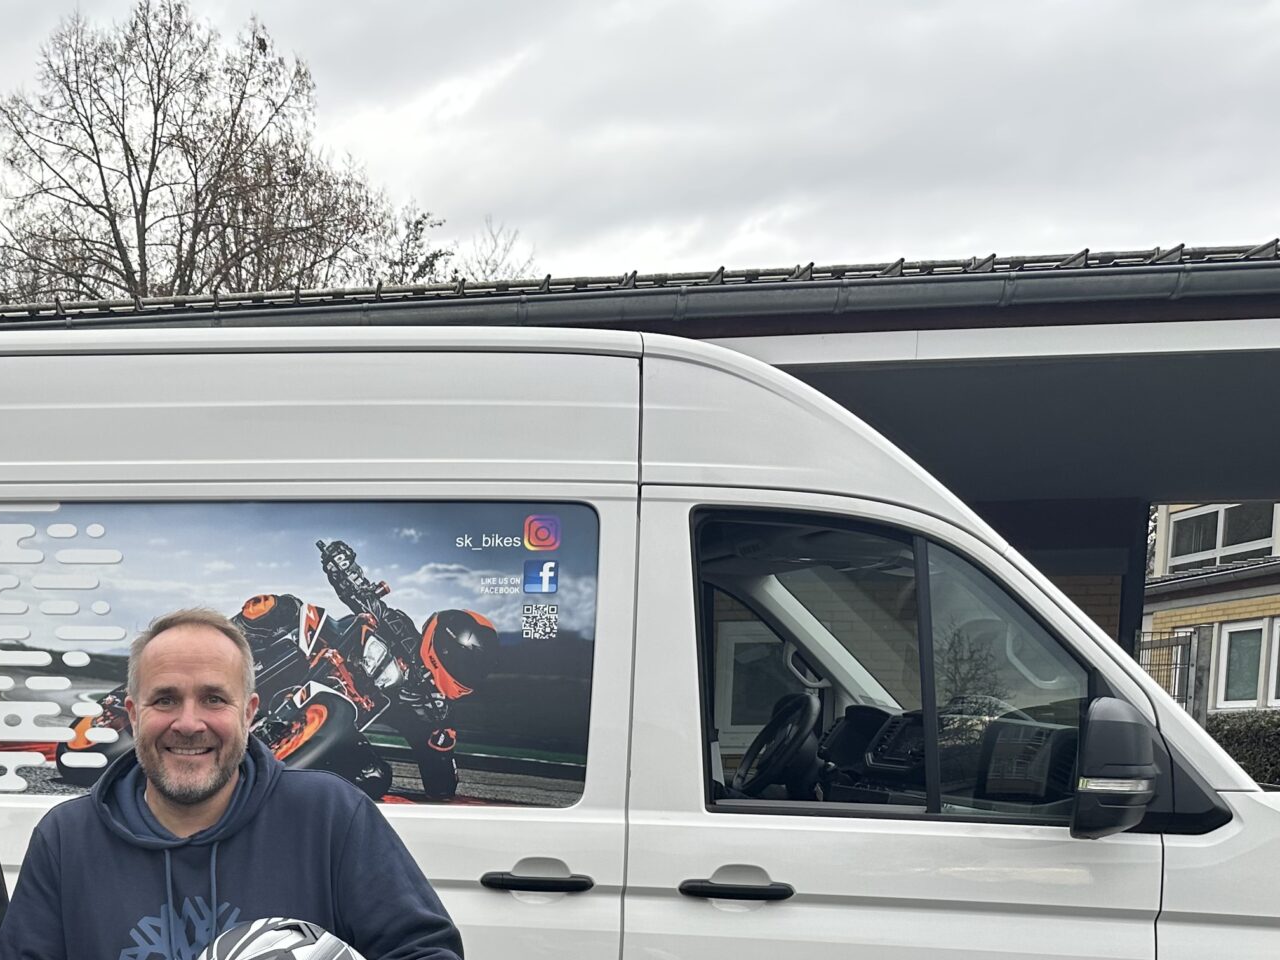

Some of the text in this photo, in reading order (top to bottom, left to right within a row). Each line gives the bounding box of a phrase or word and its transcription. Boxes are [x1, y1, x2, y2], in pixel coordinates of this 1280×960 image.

[455, 533, 522, 551] sk_bikes
[480, 577, 521, 586] LIKE US ON
[480, 586, 521, 595] FACEBOOK
